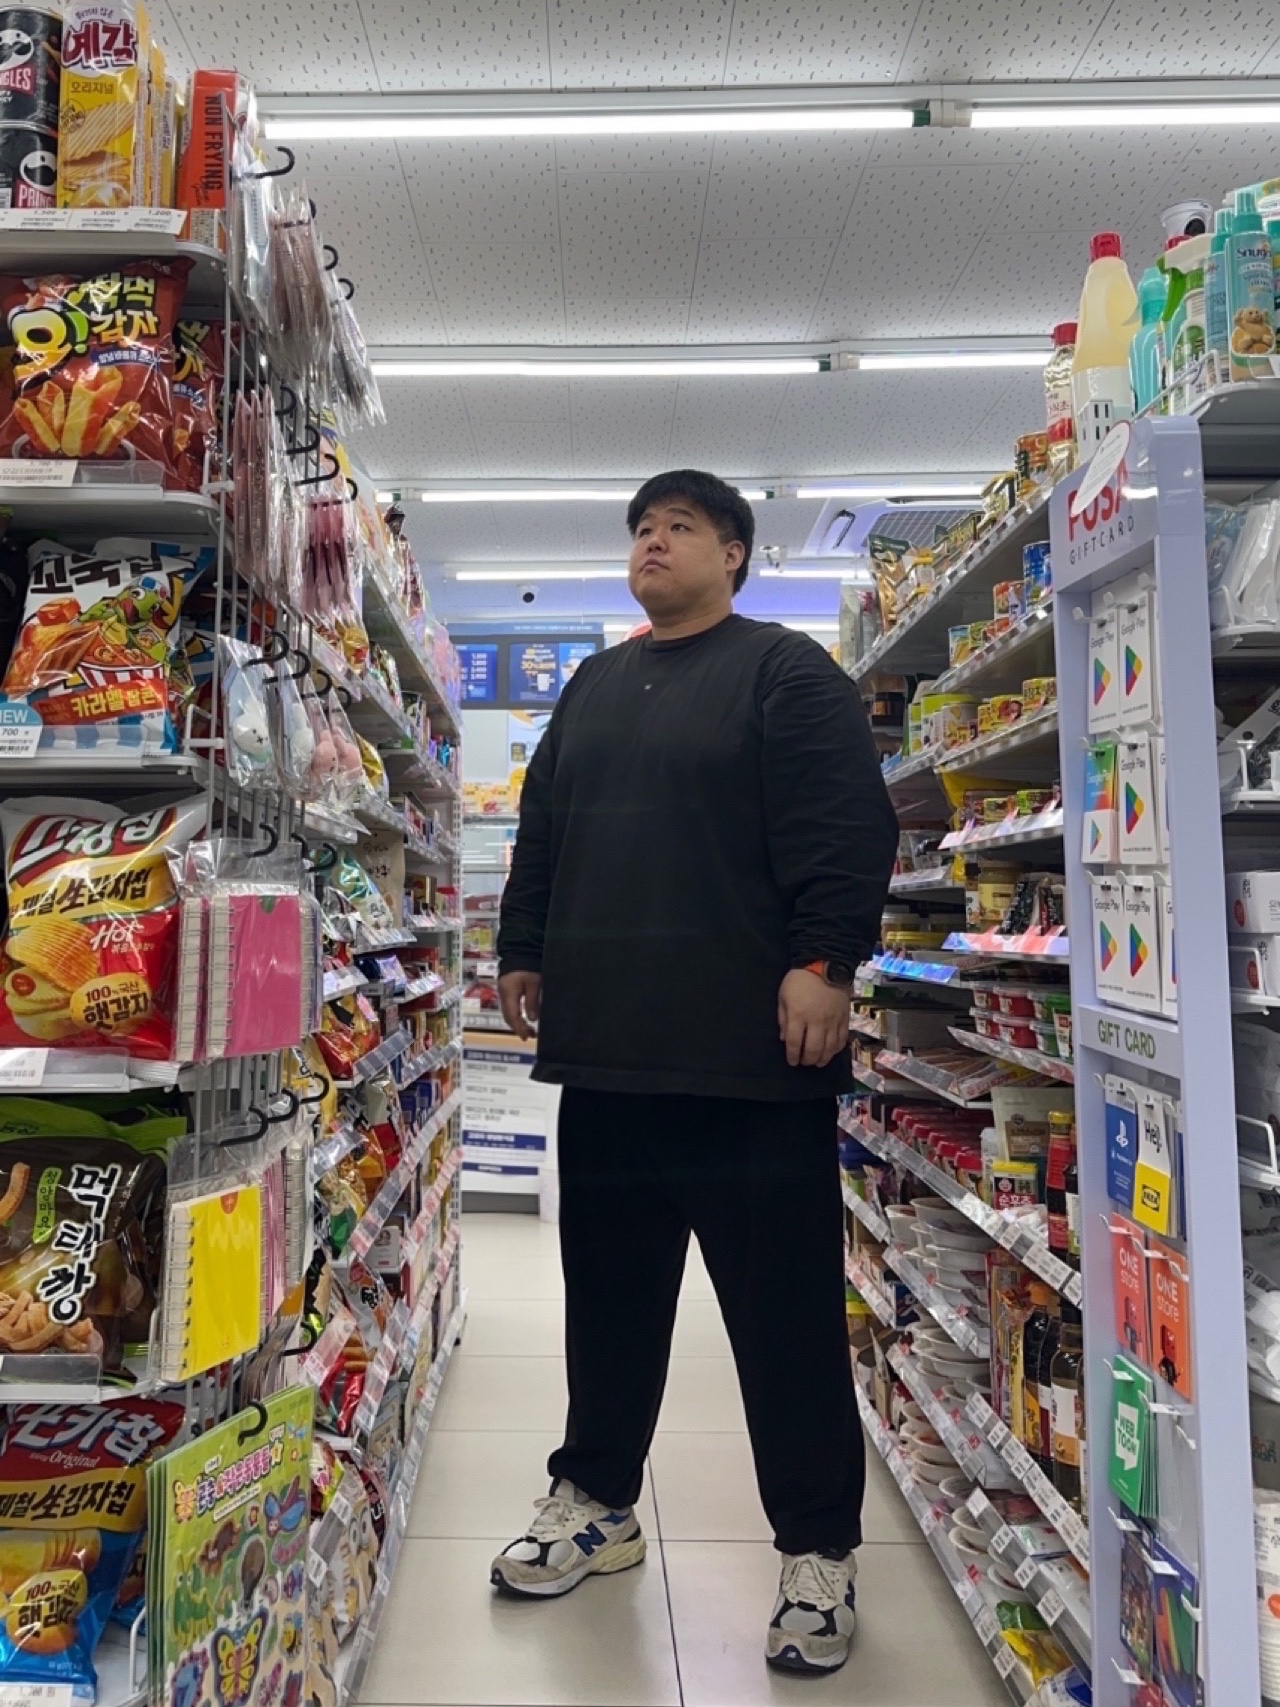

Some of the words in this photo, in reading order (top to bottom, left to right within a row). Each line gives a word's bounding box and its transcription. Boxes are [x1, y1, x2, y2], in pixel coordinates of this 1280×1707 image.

[62, 21, 134, 65] 예감
[71, 82, 114, 95] 오리지널
[205, 96, 222, 125] NON
[205, 132, 223, 190] FRYING
[91, 311, 158, 347] 감자
[71, 690, 125, 718] 카라멜
[128, 687, 160, 708] 팝콘
[9, 810, 168, 877] 스윙칩
[1095, 898, 1110, 913] Google
[1110, 899, 1120, 912] Play
[1125, 900, 1141, 914] Google
[1141, 901, 1151, 915] Play
[90, 920, 144, 950] Hot
[118, 981, 140, 995] 국산
[83, 992, 149, 1030] 햇감자
[1098, 1018, 1121, 1048] GIFT
[1124, 1026, 1157, 1060] CARD
[1143, 1191, 1158, 1207] IKEA
[38, 1163, 121, 1323] 먹태깡
[1119, 1247, 1139, 1276] ONE
[1156, 1273, 1178, 1303] ONE
[1119, 1416, 1135, 1436] WEB
[1117, 1428, 1138, 1456] TOON
[50, 1450, 100, 1469] Original
[572, 1521, 607, 1557] N
